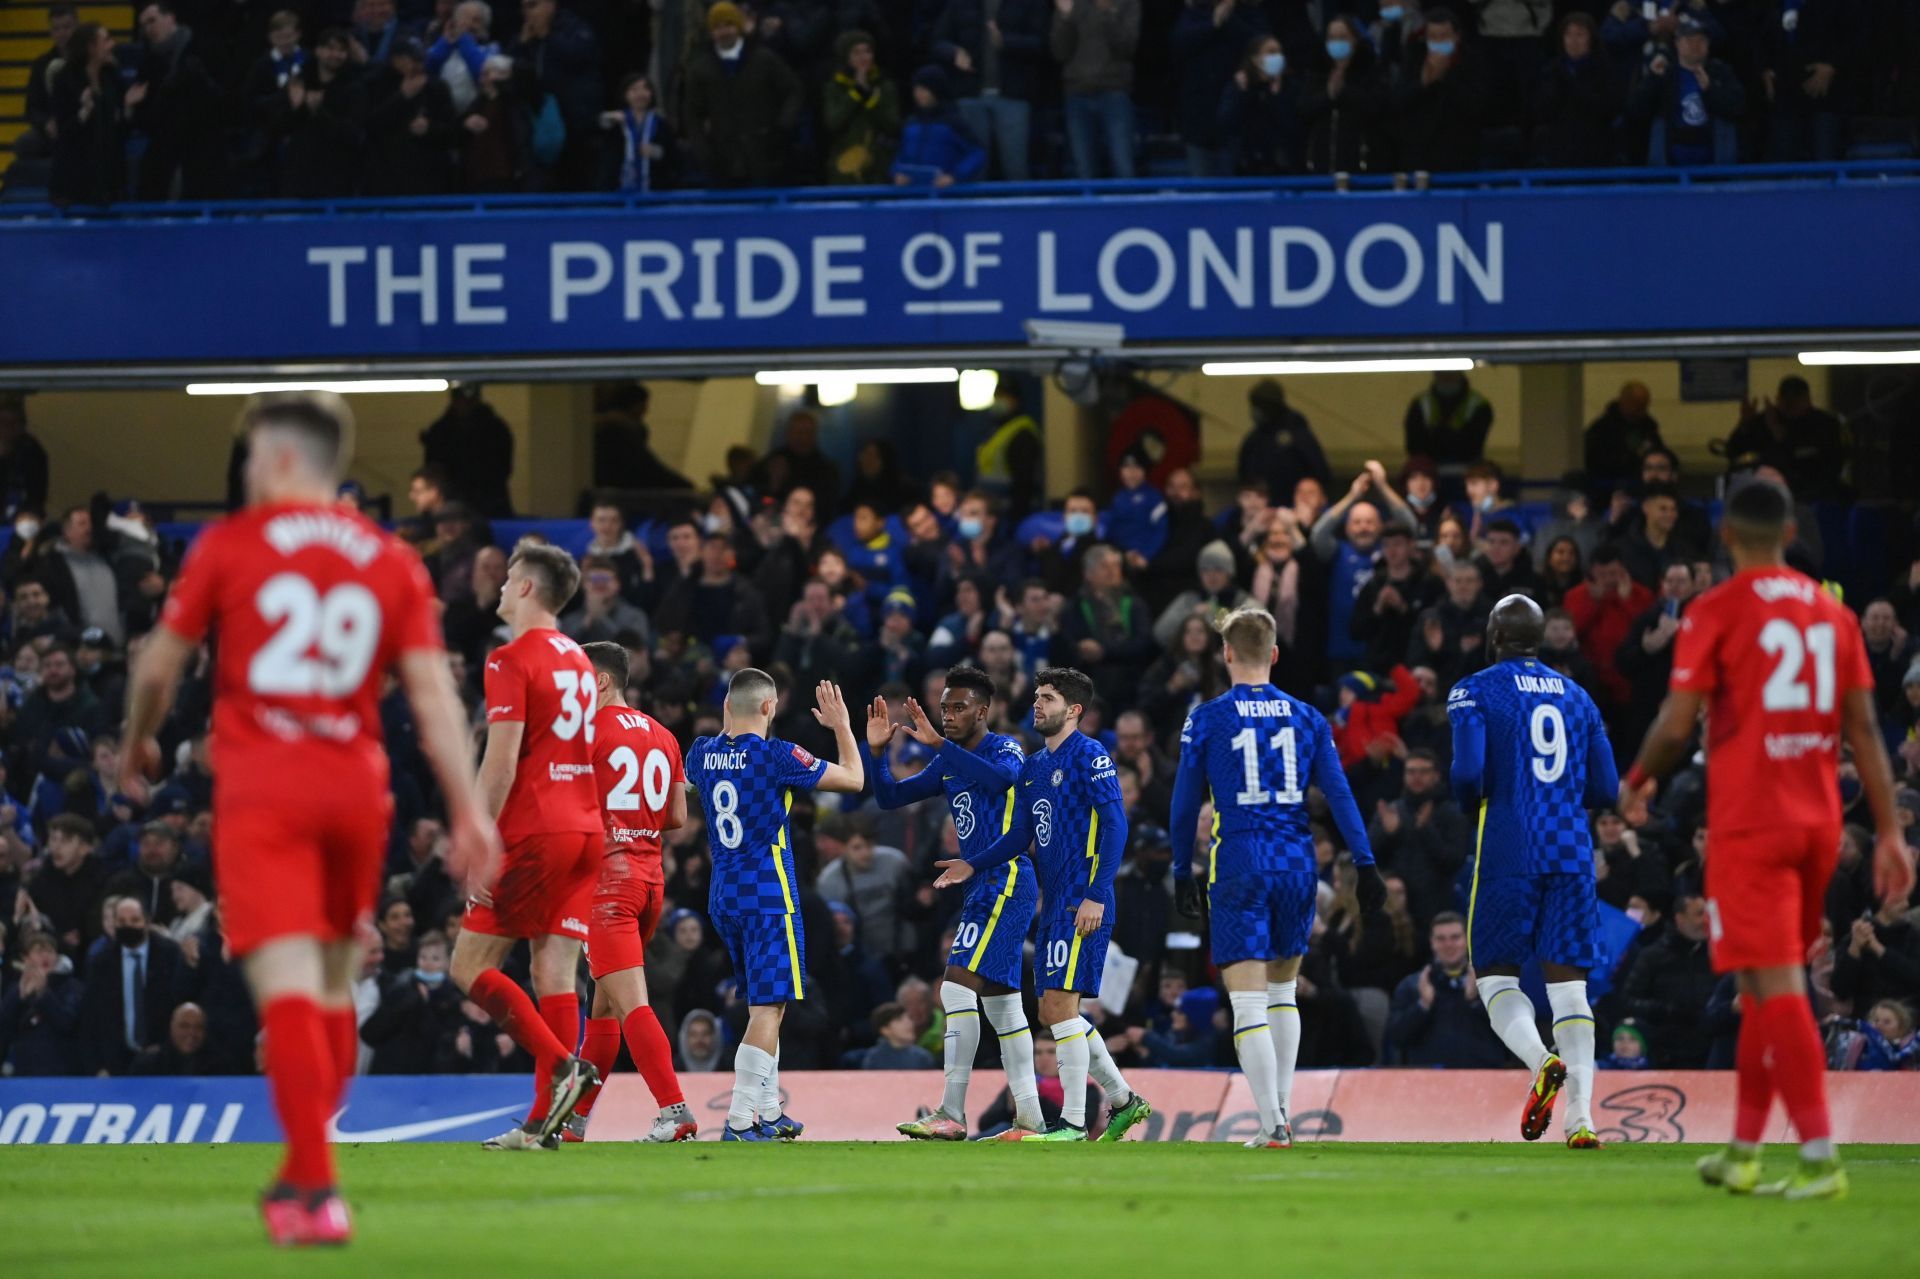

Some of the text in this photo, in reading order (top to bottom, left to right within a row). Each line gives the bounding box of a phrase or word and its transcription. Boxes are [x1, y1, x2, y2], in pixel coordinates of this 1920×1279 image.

[308, 222, 1503, 326] THE PRIDE OF LONDON
[250, 573, 381, 697] 29
[1758, 618, 1836, 713] 21
[551, 670, 598, 744] 32
[1235, 699, 1292, 717] WERNER
[1514, 675, 1565, 695] LUKAKU
[616, 713, 650, 732] KING
[1530, 703, 1568, 783] 9
[606, 746, 671, 812] 20
[703, 748, 747, 769] KOVAČIĆ
[1231, 727, 1303, 805] 11
[713, 780, 743, 849] 8
[952, 921, 979, 948] 20
[1046, 940, 1068, 968] 10
[0, 1103, 243, 1144] OTBALL
